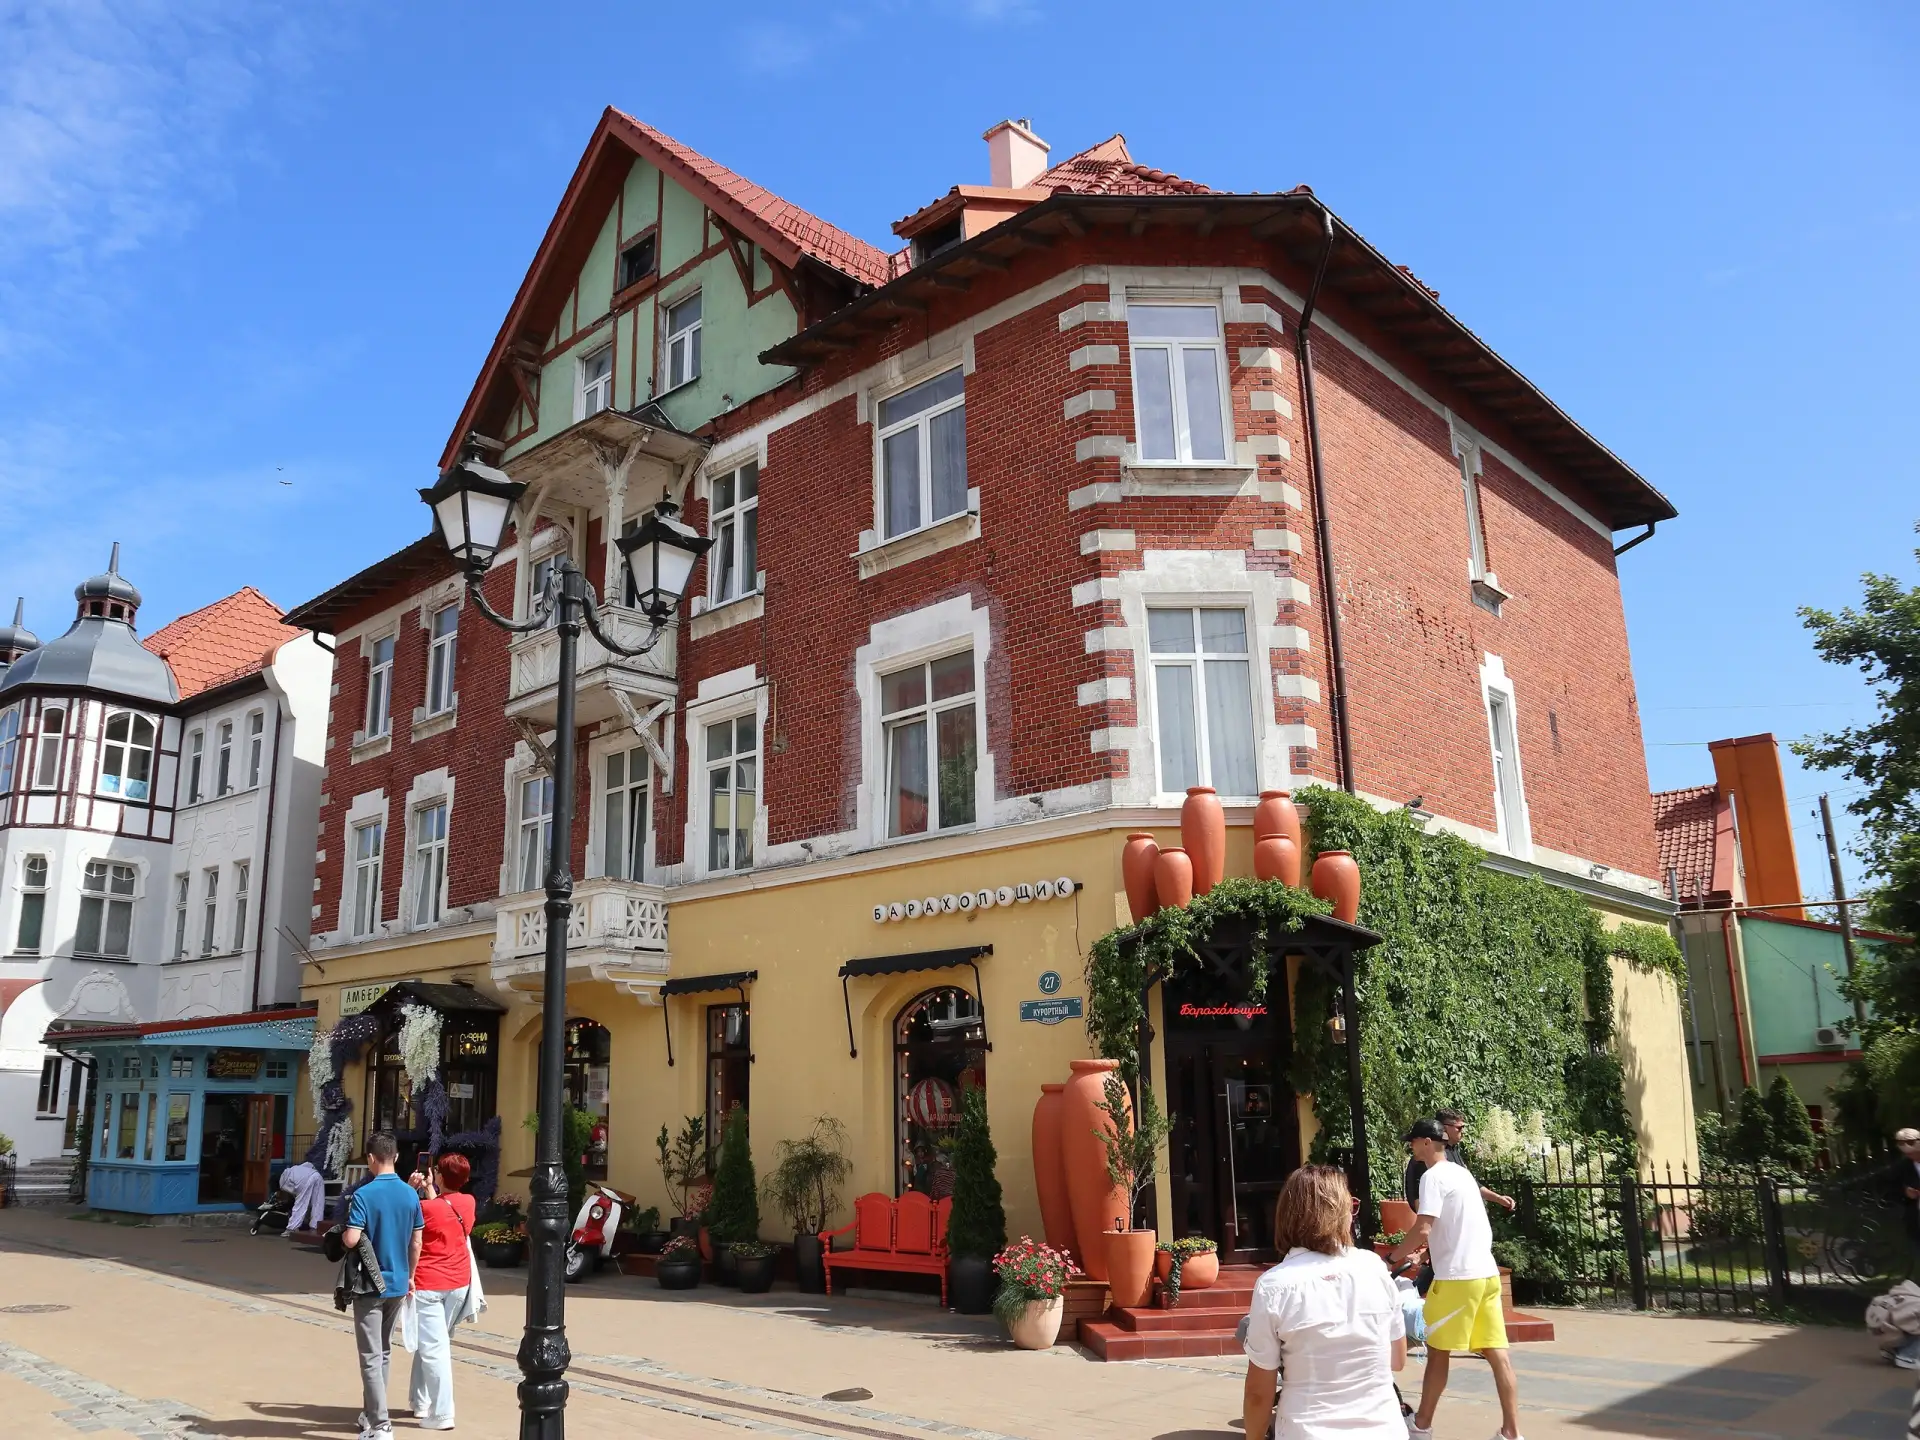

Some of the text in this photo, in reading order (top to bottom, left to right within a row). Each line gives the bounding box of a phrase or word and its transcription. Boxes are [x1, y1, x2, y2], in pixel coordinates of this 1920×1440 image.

[874, 880, 1067, 920] БАРАХОЛЬЩИК
[1044, 976, 1055, 989] 27
[1033, 1005, 1069, 1017] КУРОРТНЫЙ
